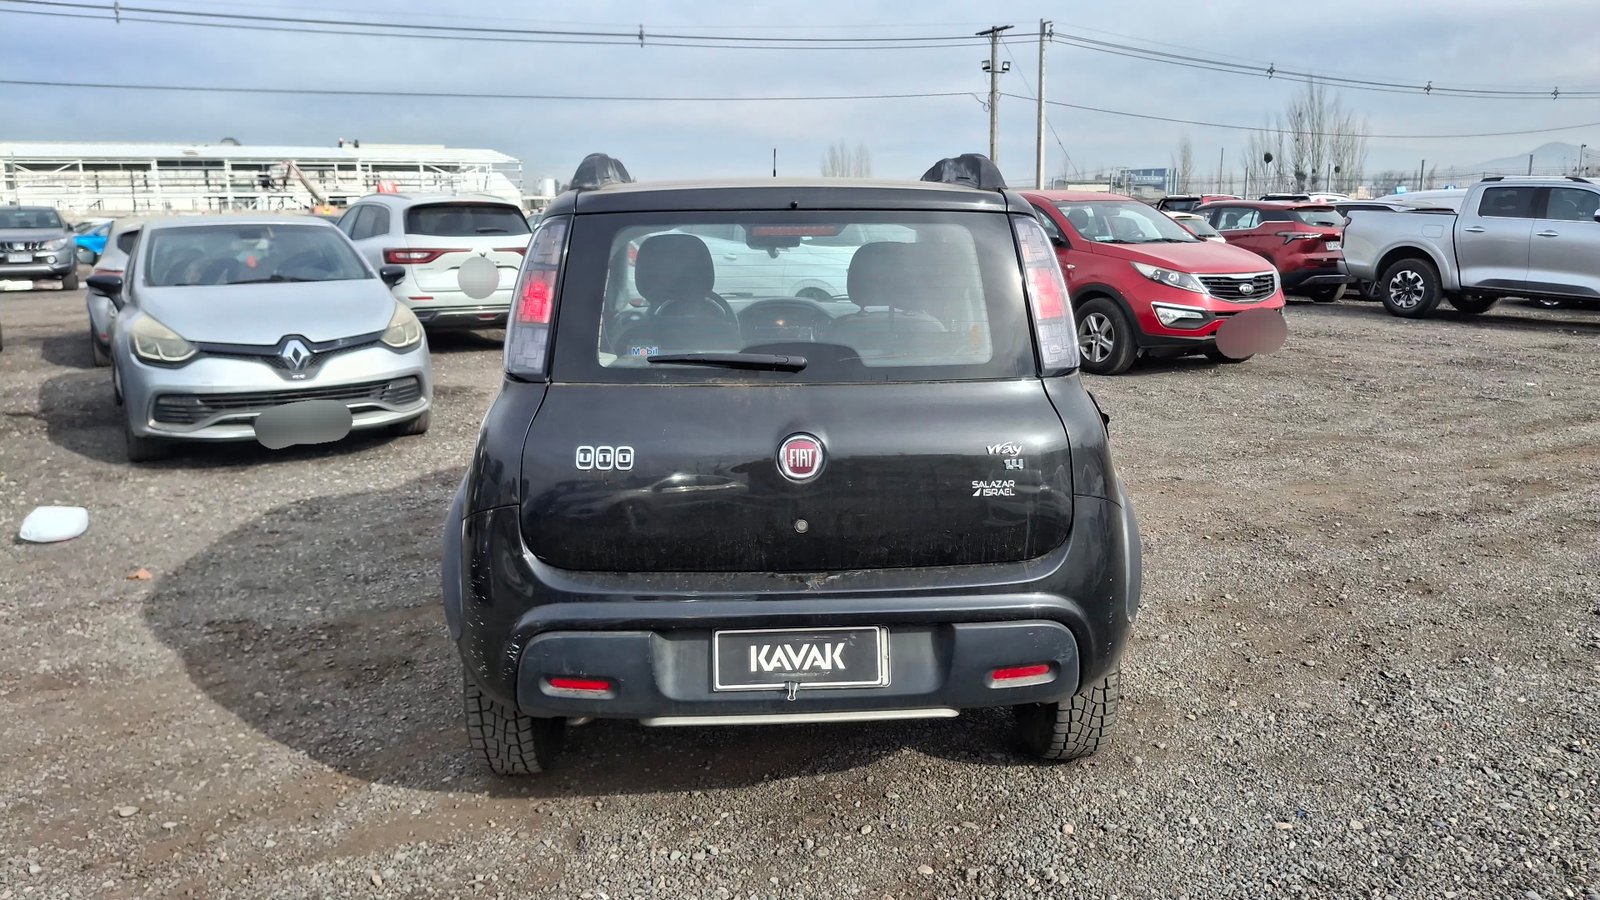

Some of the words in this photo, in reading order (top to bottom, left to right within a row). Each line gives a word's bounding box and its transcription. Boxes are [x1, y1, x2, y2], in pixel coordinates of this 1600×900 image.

[632, 347, 658, 356] Mobil
[789, 448, 814, 467] FIAT
[972, 480, 1015, 488] SALAZAR
[983, 488, 1015, 496] ISRAEL
[750, 643, 846, 672] KAVAK
